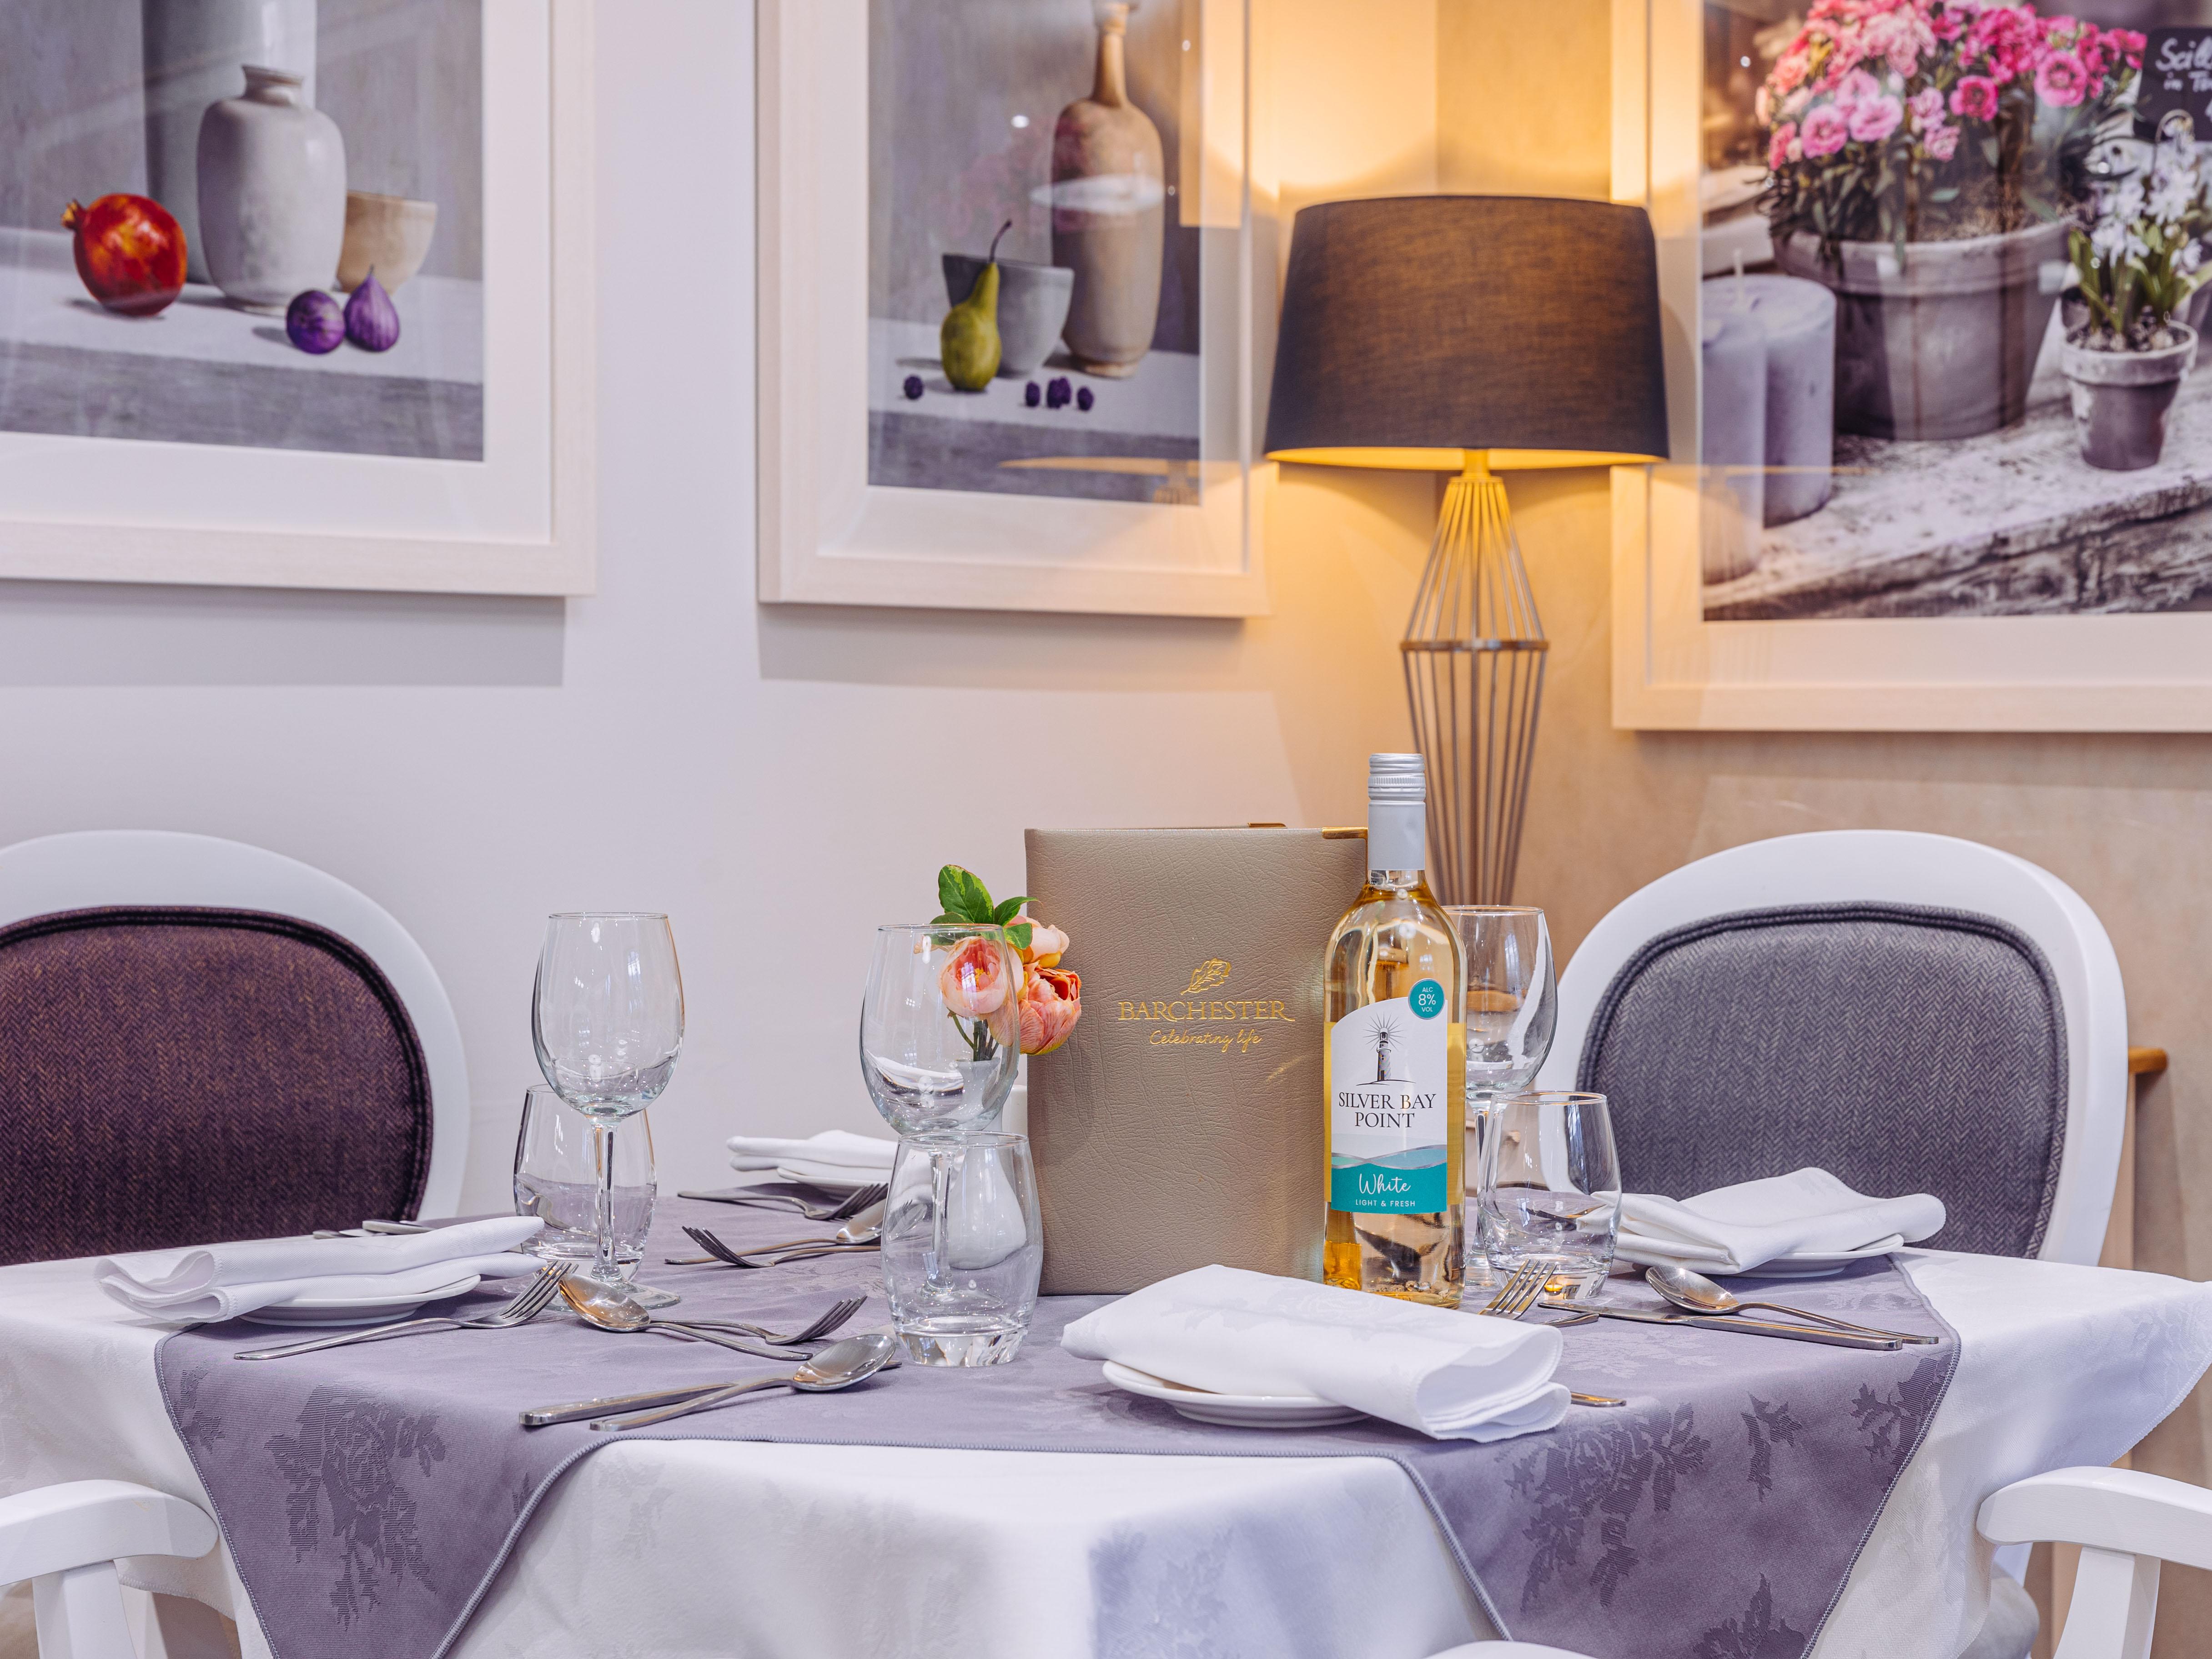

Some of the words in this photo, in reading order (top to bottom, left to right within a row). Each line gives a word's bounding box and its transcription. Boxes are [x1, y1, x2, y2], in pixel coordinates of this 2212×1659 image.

[1418, 994, 1436, 1005] 8%
[1117, 1000, 1295, 1022] BARCHESTER
[1149, 1028, 1233, 1053] Celebrating
[1236, 1028, 1262, 1053] life
[1339, 1092, 1396, 1110] SILVER
[1400, 1094, 1437, 1110] BAY
[1355, 1112, 1415, 1128] POINT
[1359, 1173, 1411, 1195] White
